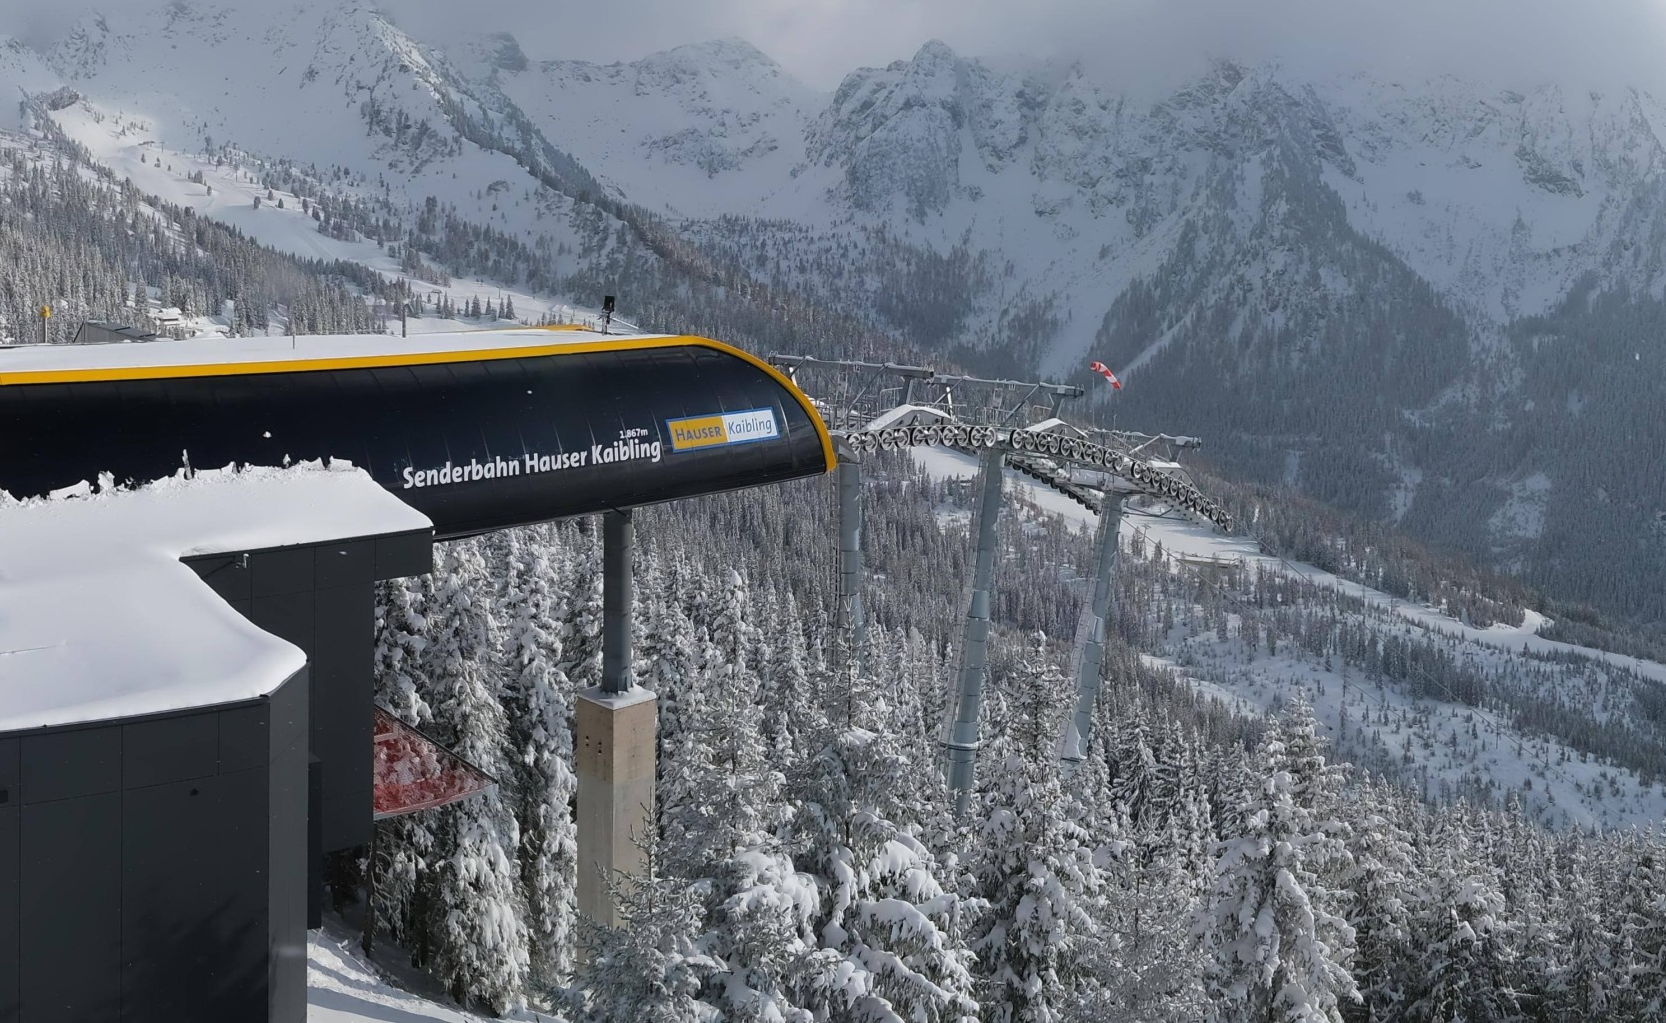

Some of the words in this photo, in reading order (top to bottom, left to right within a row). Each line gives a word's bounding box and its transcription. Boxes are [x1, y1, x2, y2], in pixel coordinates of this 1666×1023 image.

[619, 428, 648, 439] 1.867m
[675, 426, 722, 442] HAUSER
[728, 418, 772, 435] Kaibling
[403, 455, 520, 489] Senderbahn
[525, 450, 587, 473] Hauser
[591, 438, 661, 463] Kaibling
